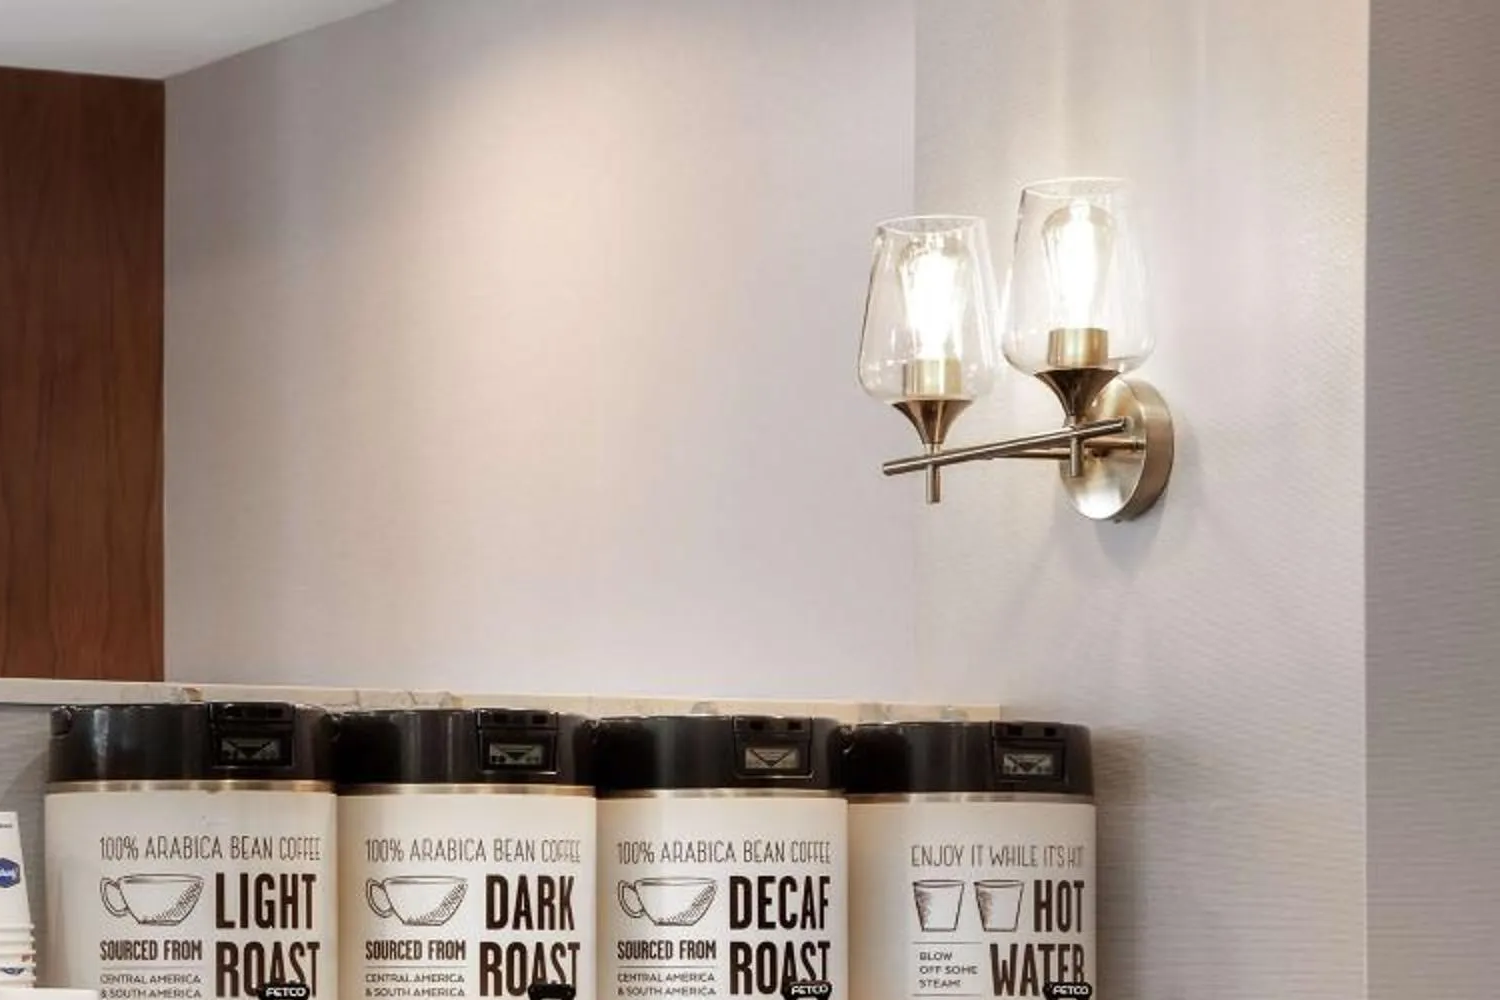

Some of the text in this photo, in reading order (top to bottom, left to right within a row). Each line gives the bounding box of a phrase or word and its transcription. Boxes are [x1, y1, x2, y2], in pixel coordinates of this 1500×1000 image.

[100, 835, 321, 861] 100% ARABICA BEAN COFFEE
[365, 839, 581, 863] 100% ARABICA BEAN COFFEE
[617, 841, 831, 865] 100% ARABICA BEAN COFFEE
[911, 845, 965, 867] ENJOY
[971, 845, 984, 867] IT
[989, 845, 1037, 867] WHILE
[215, 872, 317, 930] LIGHT
[485, 874, 575, 930] DARK
[729, 875, 831, 930] DECAF
[1033, 879, 1085, 933] HOT
[100, 940, 203, 961] SOURCED FROM
[365, 940, 466, 961] SOURCED FROM
[617, 940, 717, 960] SOURCED FROM
[919, 951, 953, 961] BLOW
[100, 973, 201, 984] CENTRAL AMERICA
[215, 941, 320, 998] ROAST
[365, 973, 465, 983] CENTRAL AMERICA
[479, 941, 581, 997] ROAST
[617, 972, 715, 983] CENTRAL AMERICA
[729, 941, 831, 995] ROAST
[919, 965, 978, 975] OFF SOME
[989, 943, 1085, 997] WATER
[100, 988, 202, 999] & SOUTH AMERICA
[265, 986, 306, 997] FETCO
[365, 988, 466, 997] & SOUTH AMERICA
[617, 986, 717, 997] & SOUTH AMERICA
[790, 984, 829, 996] FETCO
[1051, 985, 1089, 996] FETCO
